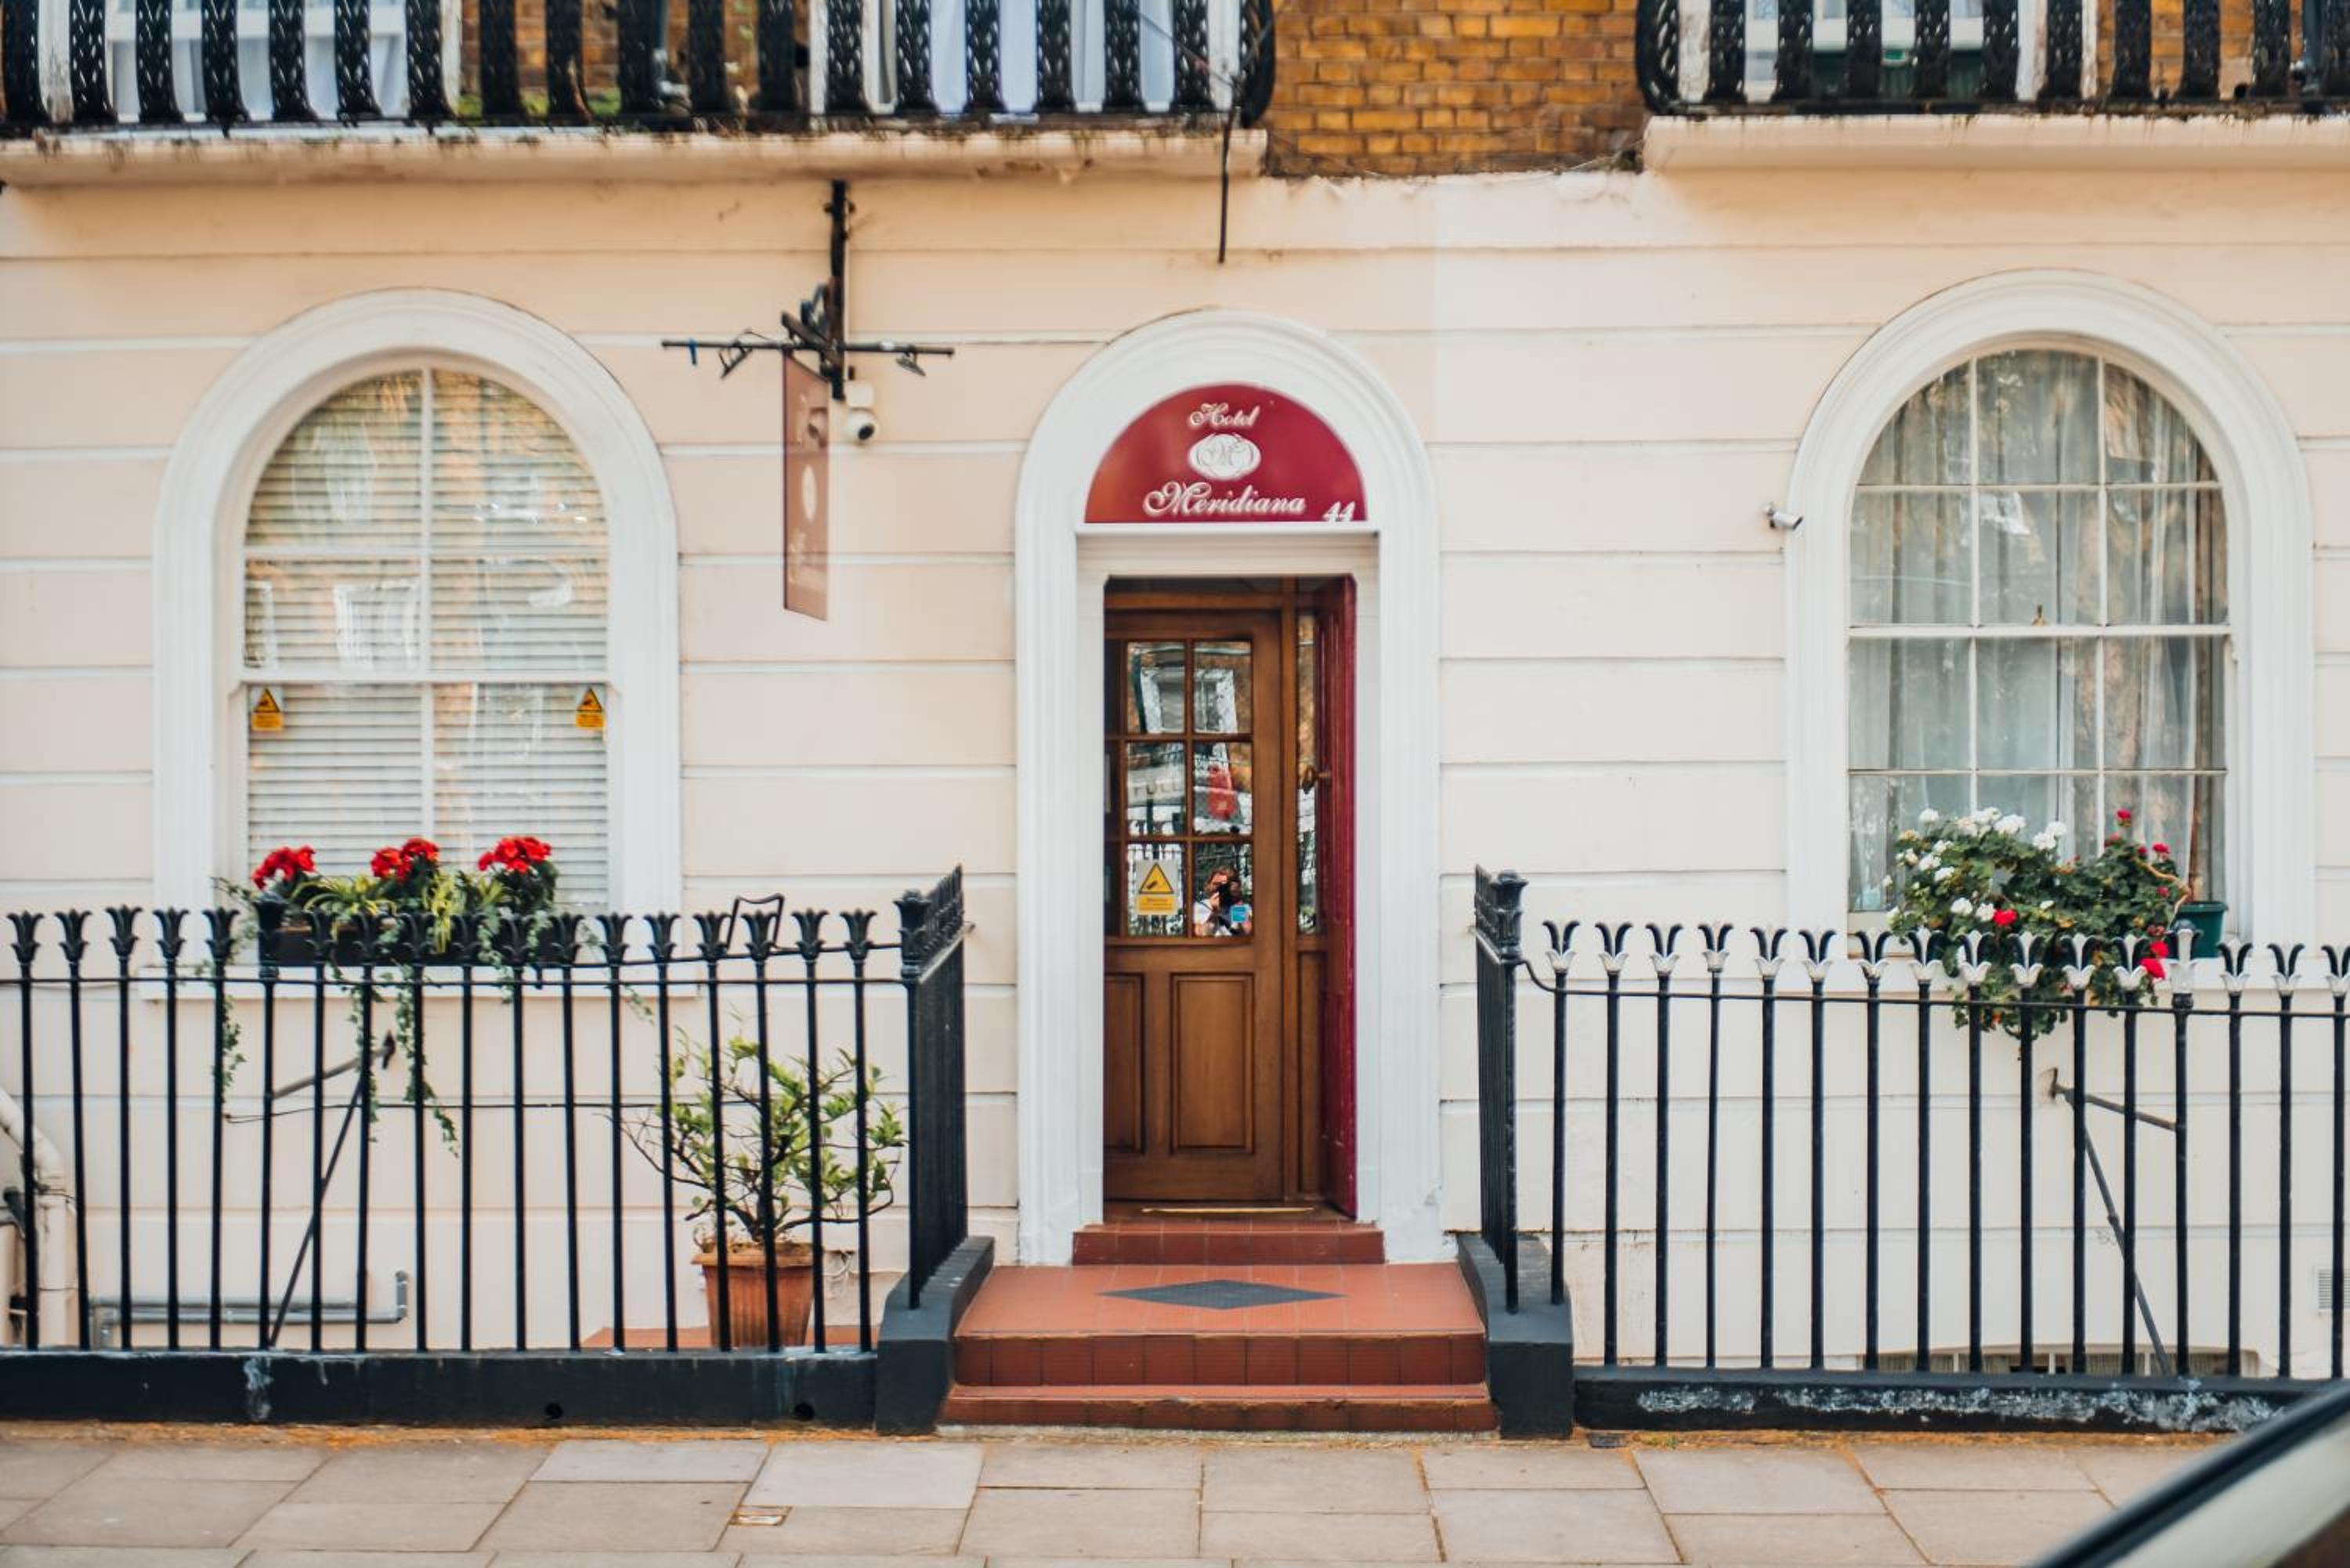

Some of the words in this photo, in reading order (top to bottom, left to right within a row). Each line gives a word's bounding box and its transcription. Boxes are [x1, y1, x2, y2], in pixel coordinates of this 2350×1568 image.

[1188, 402, 1260, 428] Hotel
[1143, 481, 1307, 517] Meridiana
[1321, 500, 1356, 523] 44
